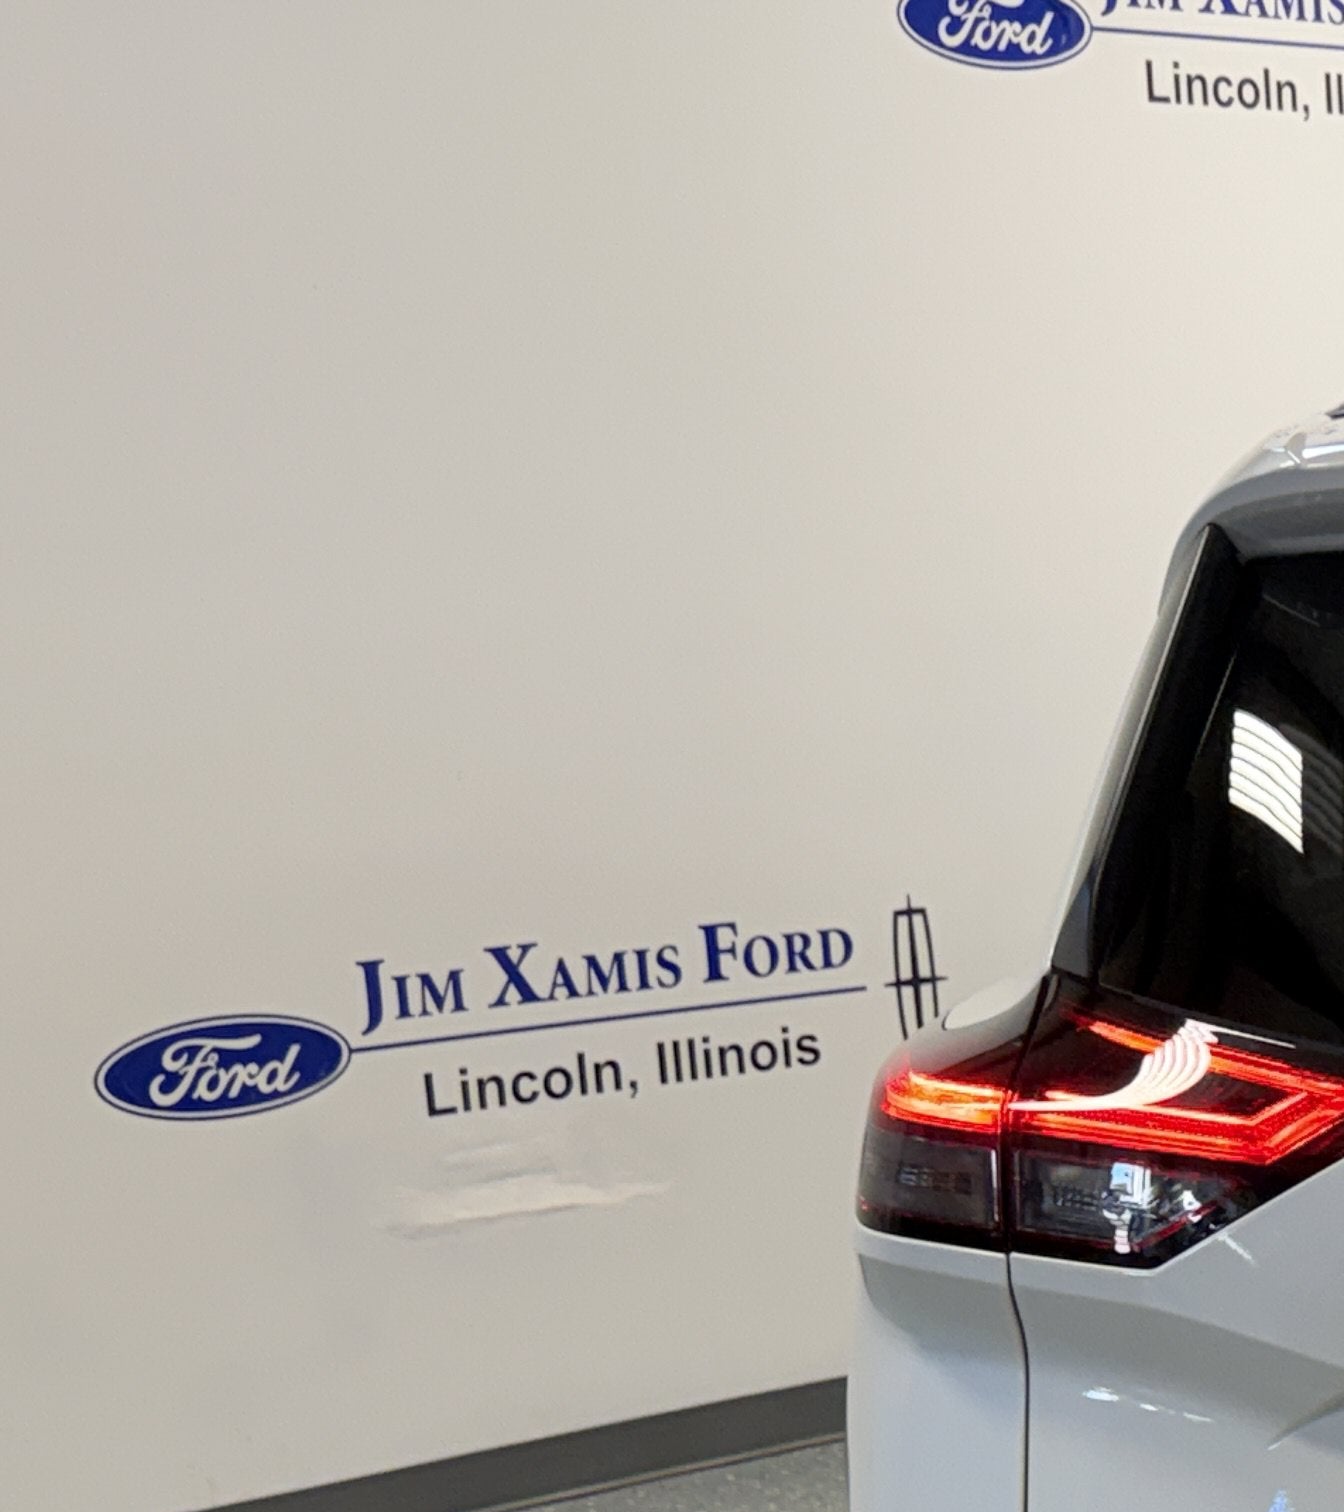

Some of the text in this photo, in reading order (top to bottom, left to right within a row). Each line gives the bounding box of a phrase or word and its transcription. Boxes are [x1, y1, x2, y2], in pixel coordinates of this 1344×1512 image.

[938, 0, 1053, 54] Ford
[1145, 59, 1311, 122] Lincoln,
[356, 921, 854, 1037] JIM XAMIS FORD
[149, 1033, 301, 1106] Ford
[423, 1027, 822, 1119] Lincoln, Illinois
